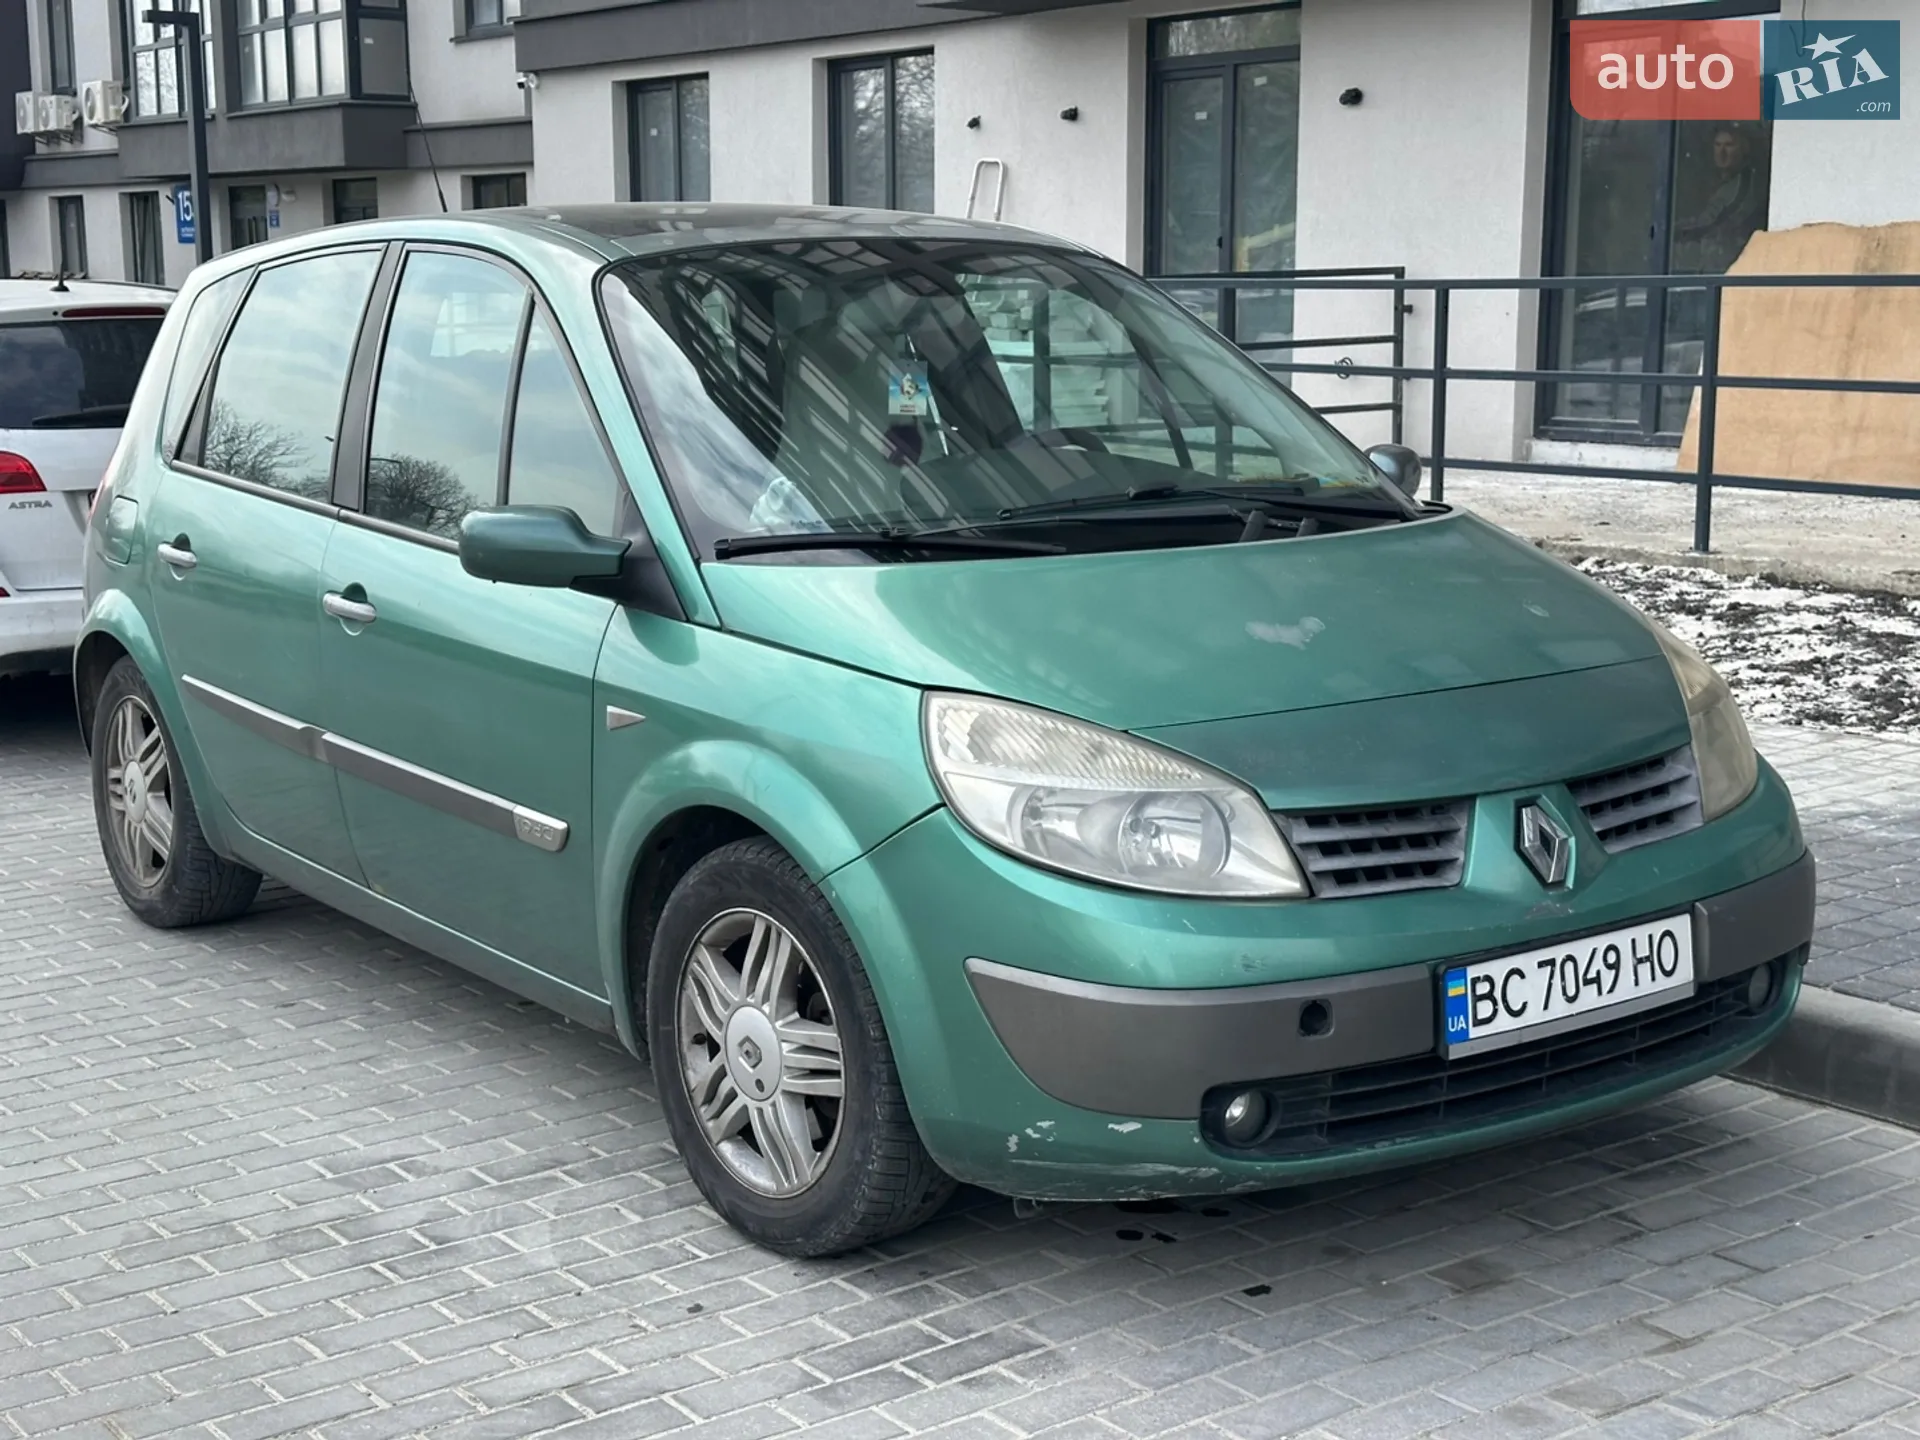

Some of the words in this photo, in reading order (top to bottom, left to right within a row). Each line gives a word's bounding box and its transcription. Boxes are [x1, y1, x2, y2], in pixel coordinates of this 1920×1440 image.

[178, 190, 195, 222] 15
[8, 500, 53, 510] ASTRA
[1470, 966, 1528, 1028] BC
[1537, 943, 1621, 1011] 7049
[1631, 929, 1679, 987] HO
[1448, 1016, 1467, 1032] UA
